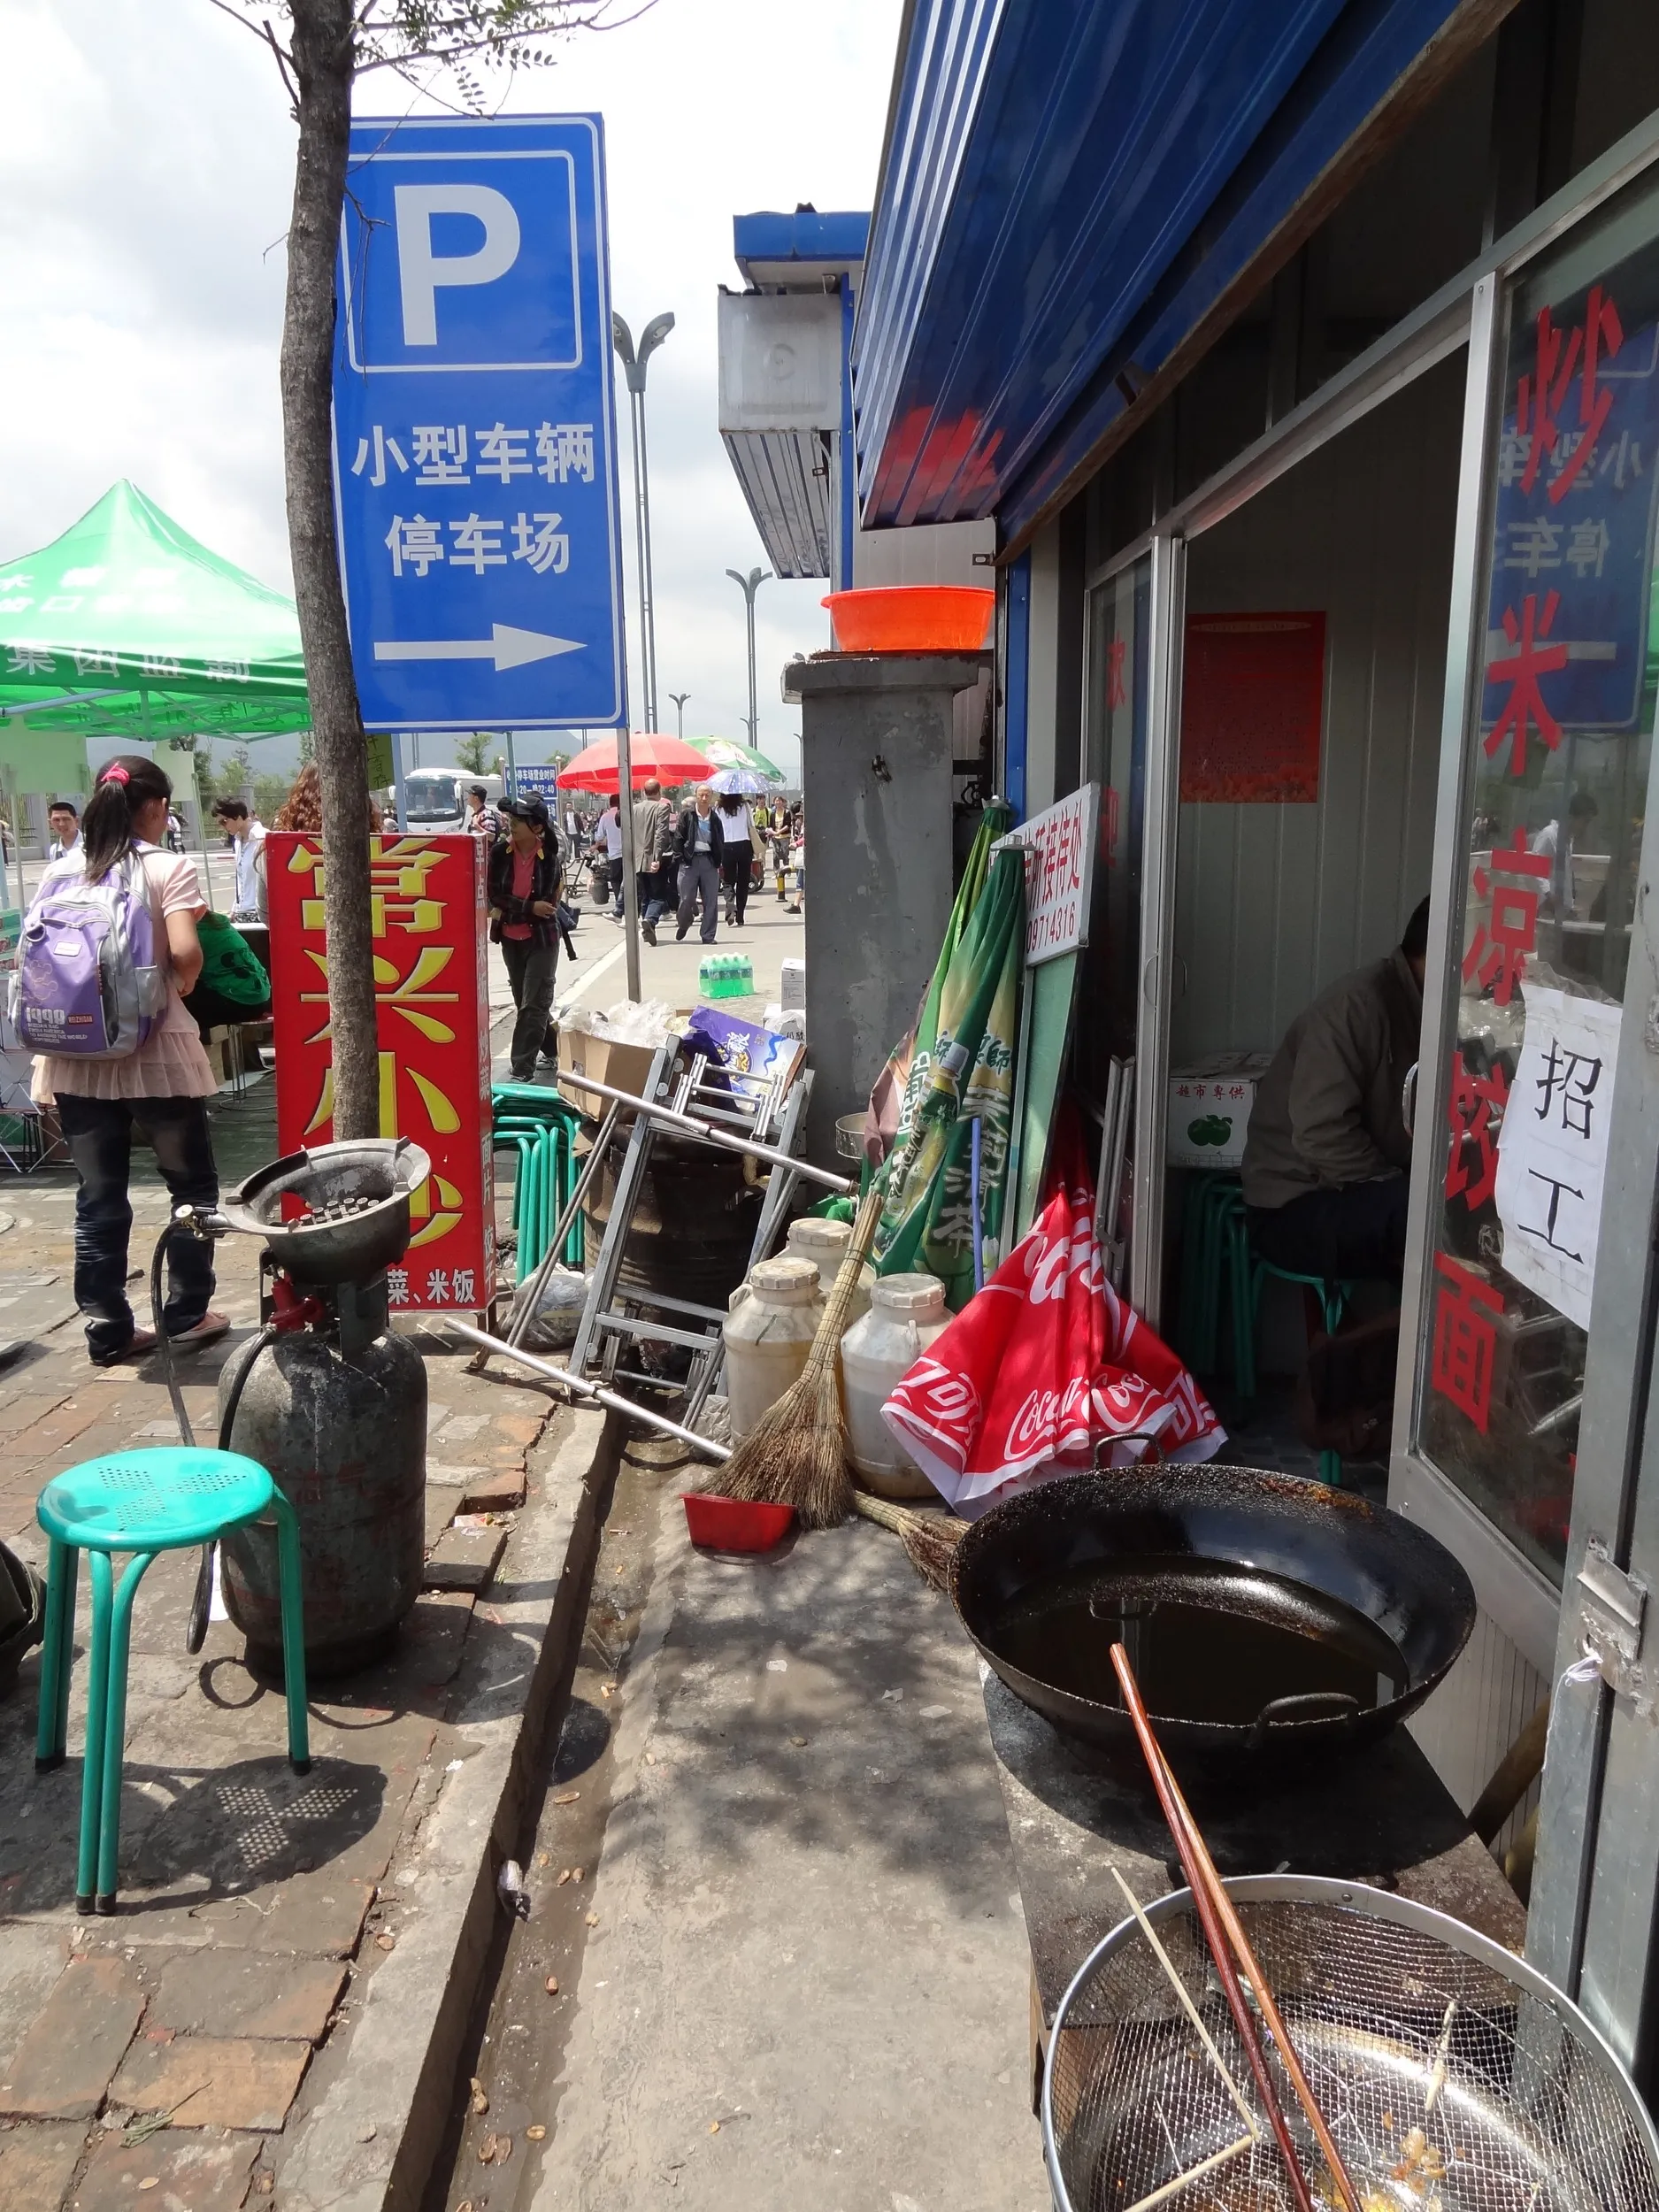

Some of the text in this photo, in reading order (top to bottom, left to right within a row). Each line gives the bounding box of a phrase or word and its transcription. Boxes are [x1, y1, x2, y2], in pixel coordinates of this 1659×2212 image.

[394, 184, 520, 346] P
[351, 421, 595, 487] 小型车辆
[385, 512, 570, 577] 停车场
[481, 1133, 493, 1205] 面片
[1518, 1035, 1603, 1265] 招工
[387, 1268, 476, 1305] 菜、米饭
